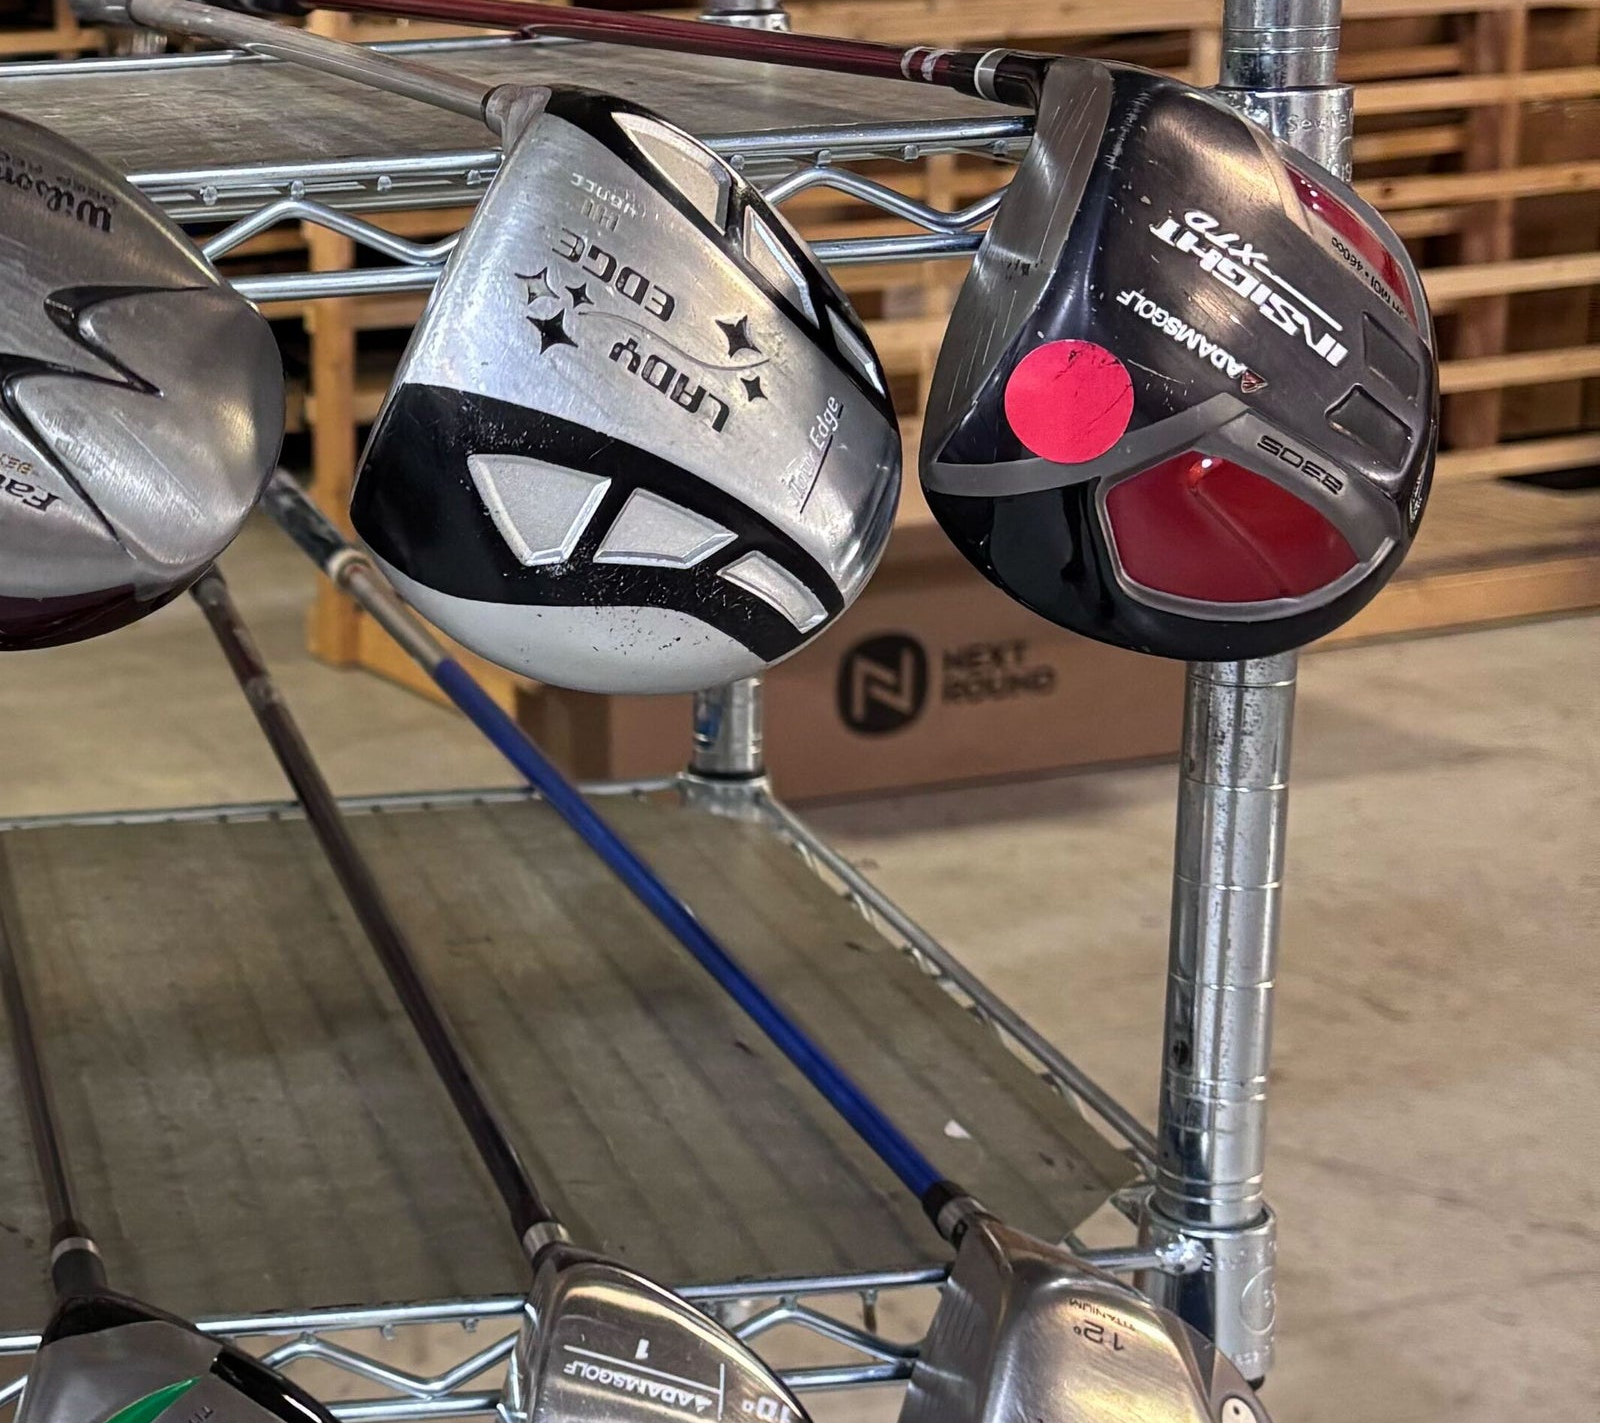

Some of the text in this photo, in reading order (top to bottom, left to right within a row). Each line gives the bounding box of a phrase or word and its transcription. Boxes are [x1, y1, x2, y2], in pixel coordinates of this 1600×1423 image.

[551, 226, 676, 323] EDGE
[1148, 210, 1349, 368] INSIGHT XTD
[1116, 288, 1246, 379] ADAMSGOLF
[608, 335, 732, 434] LADY
[809, 395, 839, 451] Edge
[942, 639, 1027, 669] NEXT
[1069, 1297, 1136, 1333] TITANIUM
[563, 1360, 699, 1410] ADAMSGOLF
